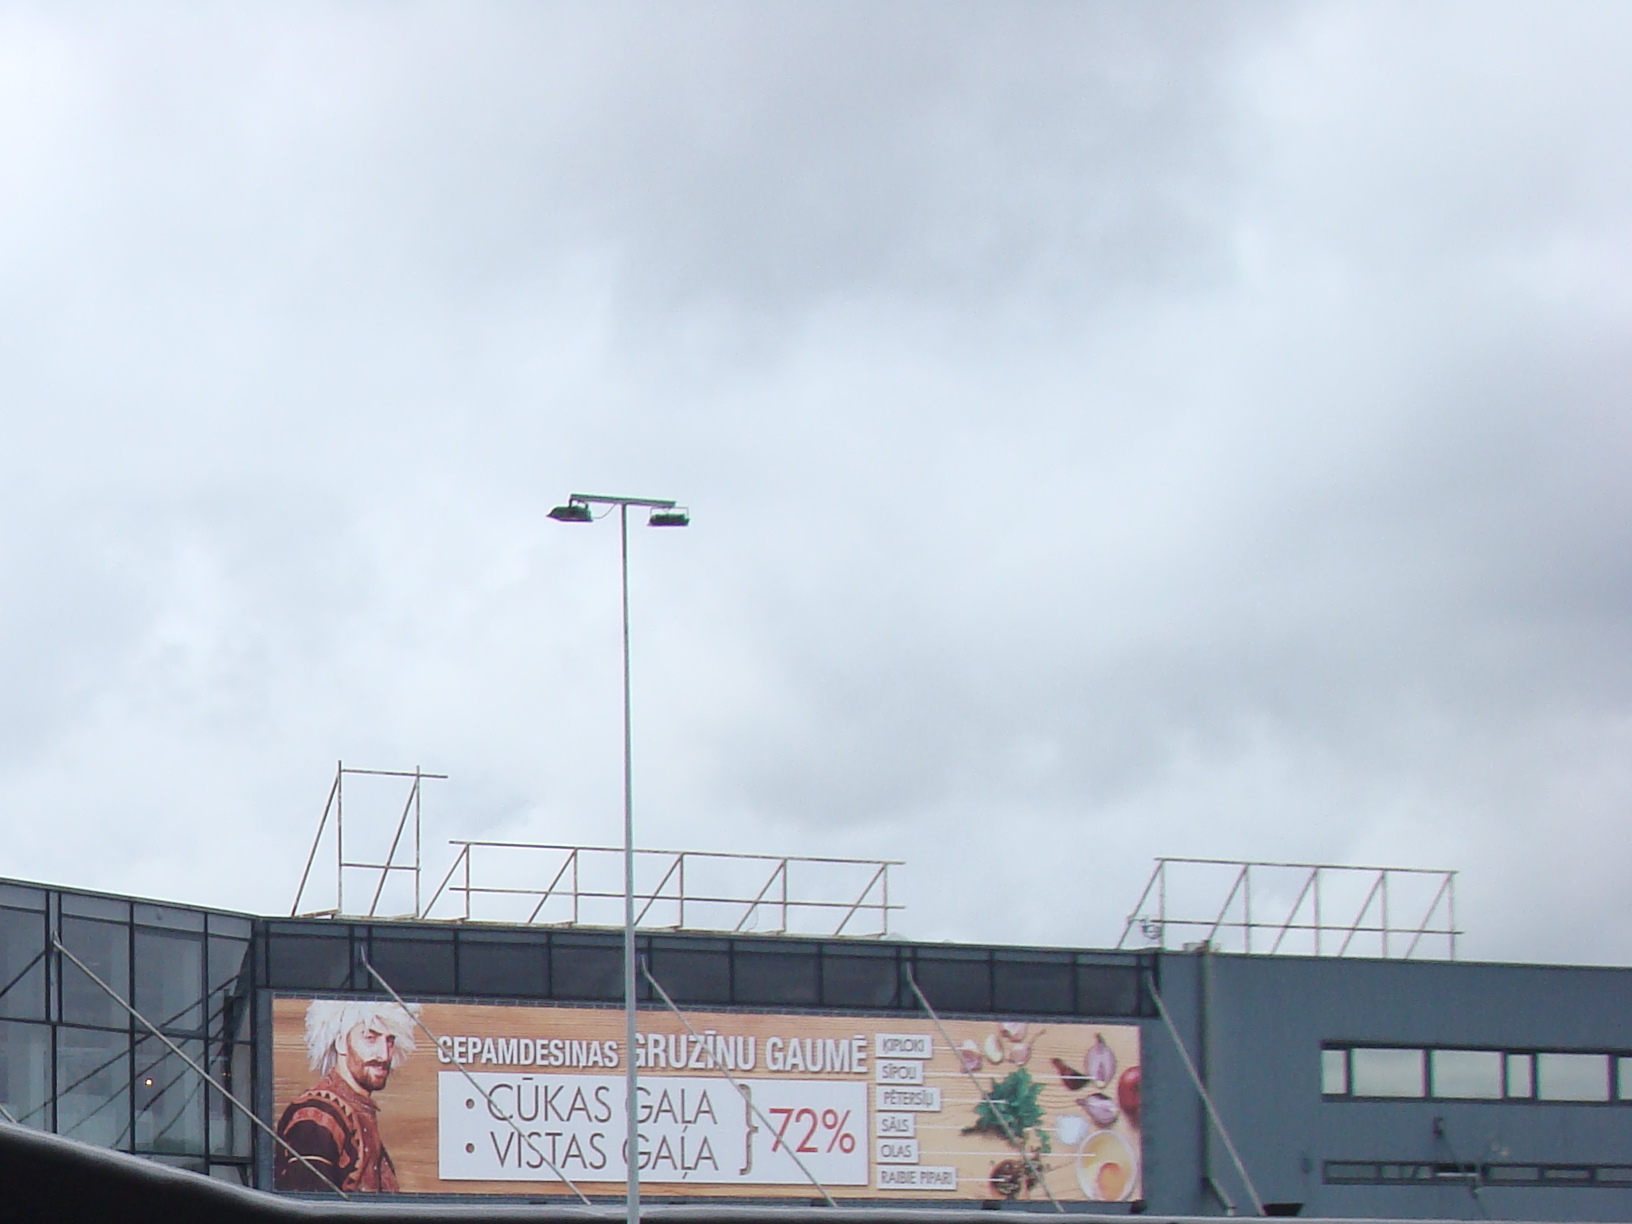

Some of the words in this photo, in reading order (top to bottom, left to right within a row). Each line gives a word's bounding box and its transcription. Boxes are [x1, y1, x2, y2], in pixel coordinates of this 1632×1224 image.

[437, 1035, 619, 1068] CEPAMDESIŅAS
[628, 1029, 756, 1070] GRUZĪNU
[766, 1034, 868, 1073] GAUMĒ
[487, 1076, 612, 1123] CŪKAS
[625, 1085, 718, 1133] GAĻA
[881, 1116, 909, 1132] SĀLS
[769, 1107, 856, 1154] 72%
[880, 1144, 913, 1158] OLAS
[490, 1130, 608, 1170] VISTAS
[622, 1133, 719, 1180] GAĻA
